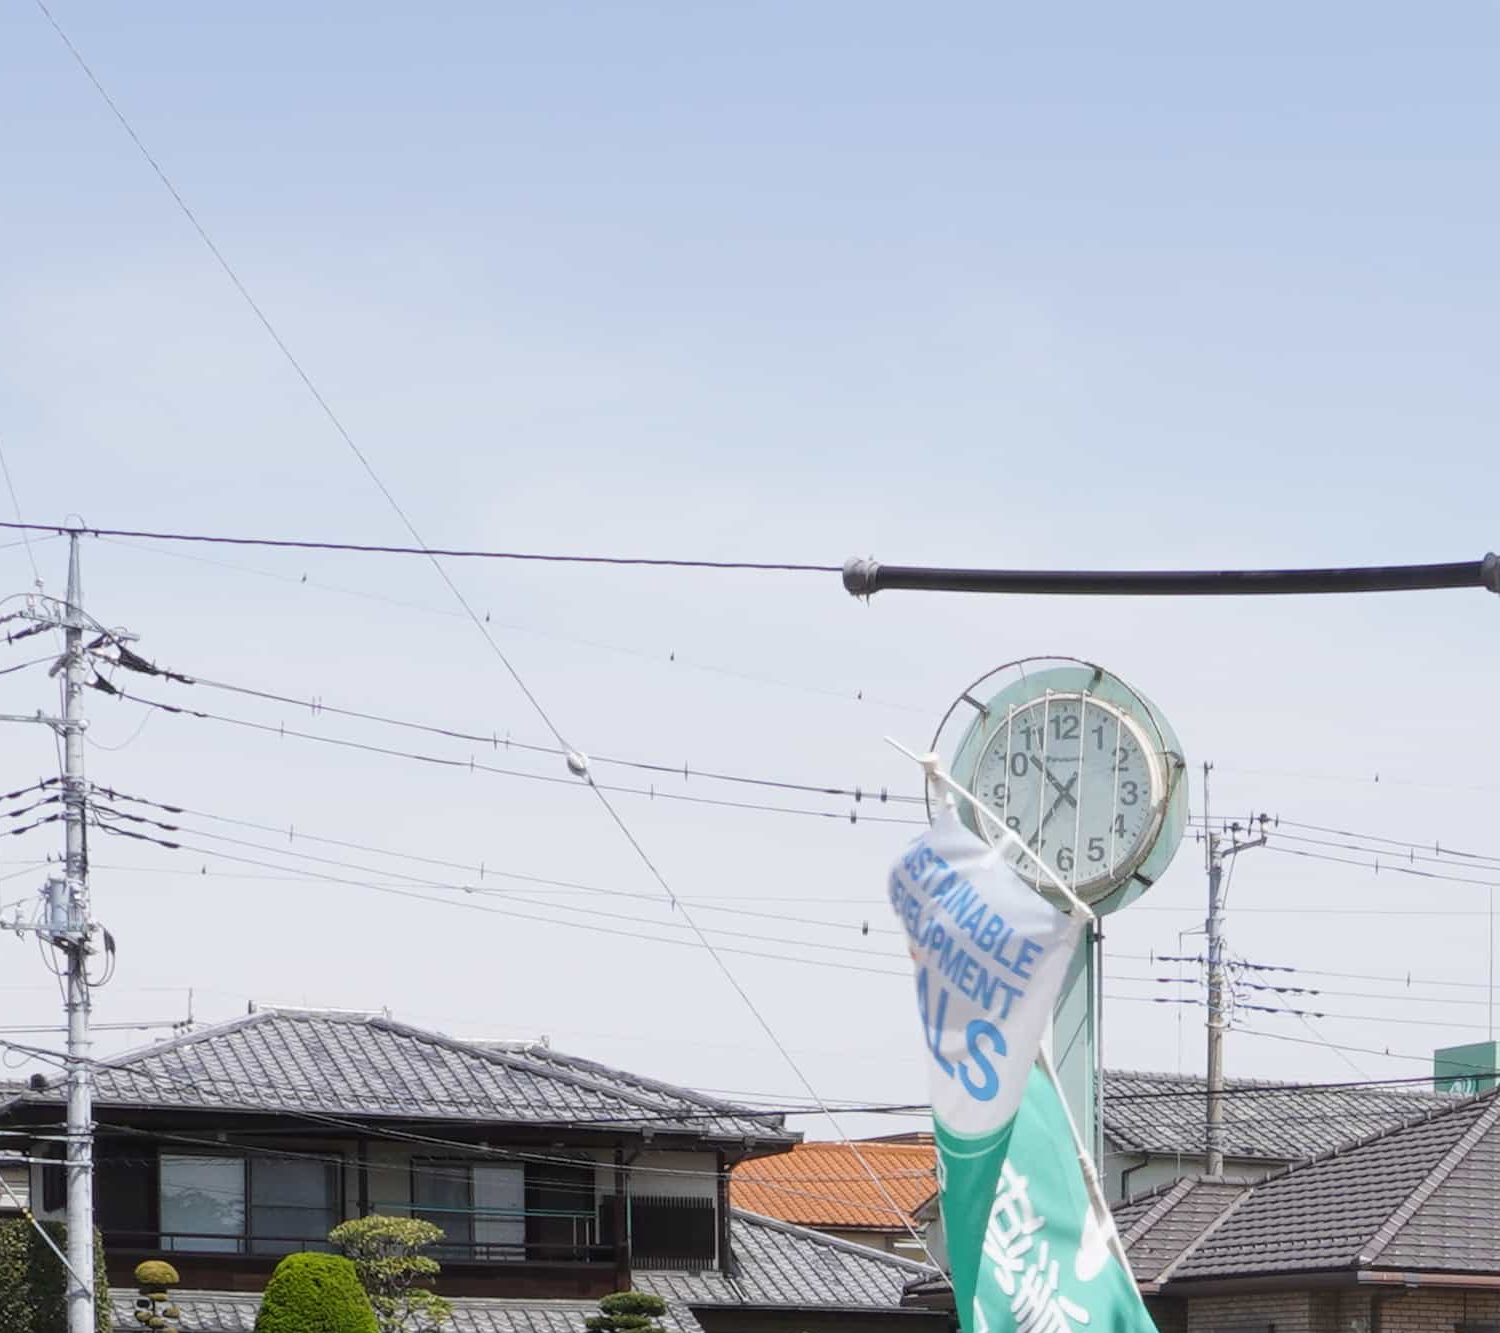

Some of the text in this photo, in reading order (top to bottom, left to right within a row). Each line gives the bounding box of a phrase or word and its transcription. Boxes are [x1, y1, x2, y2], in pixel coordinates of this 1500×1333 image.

[1049, 715, 1080, 740] 12
[1092, 725, 1104, 750] 1
[999, 752, 1029, 777] 10
[1112, 749, 1130, 772] 2
[993, 783, 1011, 808] 9
[1121, 781, 1139, 805] 3
[1109, 813, 1128, 839] 4
[1056, 847, 1074, 872] 6
[1087, 838, 1106, 862] 5
